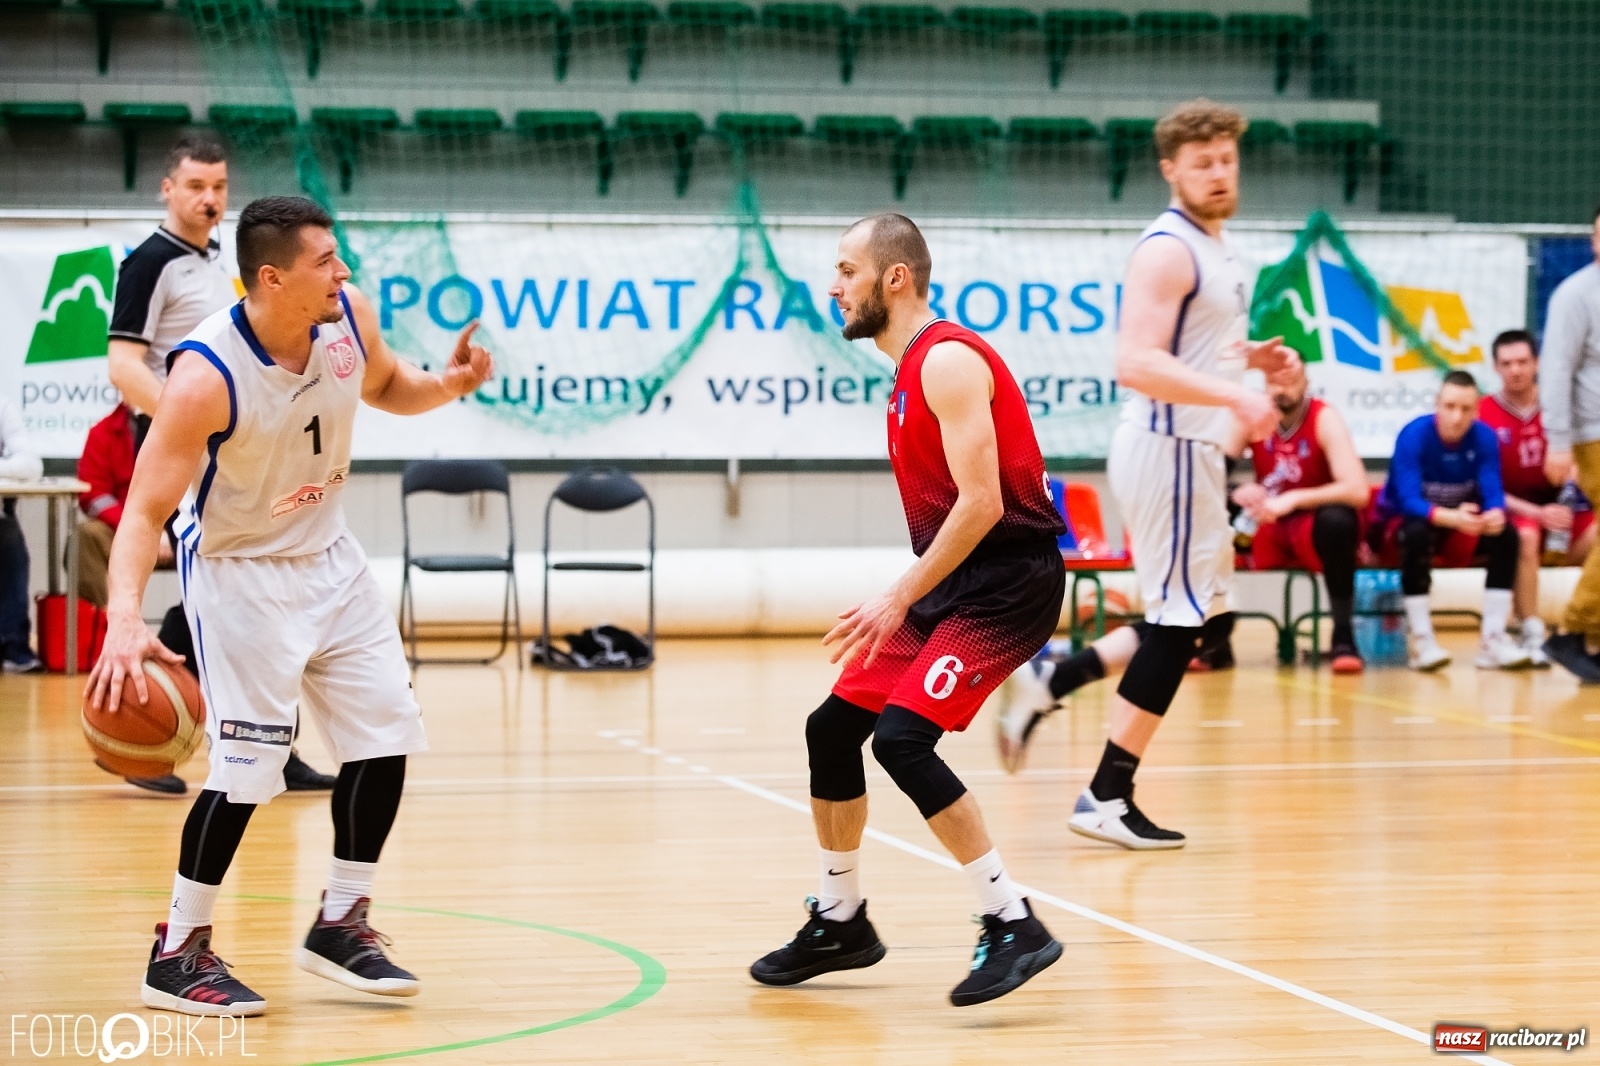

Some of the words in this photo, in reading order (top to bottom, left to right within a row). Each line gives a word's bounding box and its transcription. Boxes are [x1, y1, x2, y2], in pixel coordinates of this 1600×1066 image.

[379, 275, 696, 331] POWIAT
[723, 279, 1121, 334] RAORS
[708, 366, 894, 415] wspier
[303, 415, 322, 455] 1
[923, 654, 964, 700] 6
